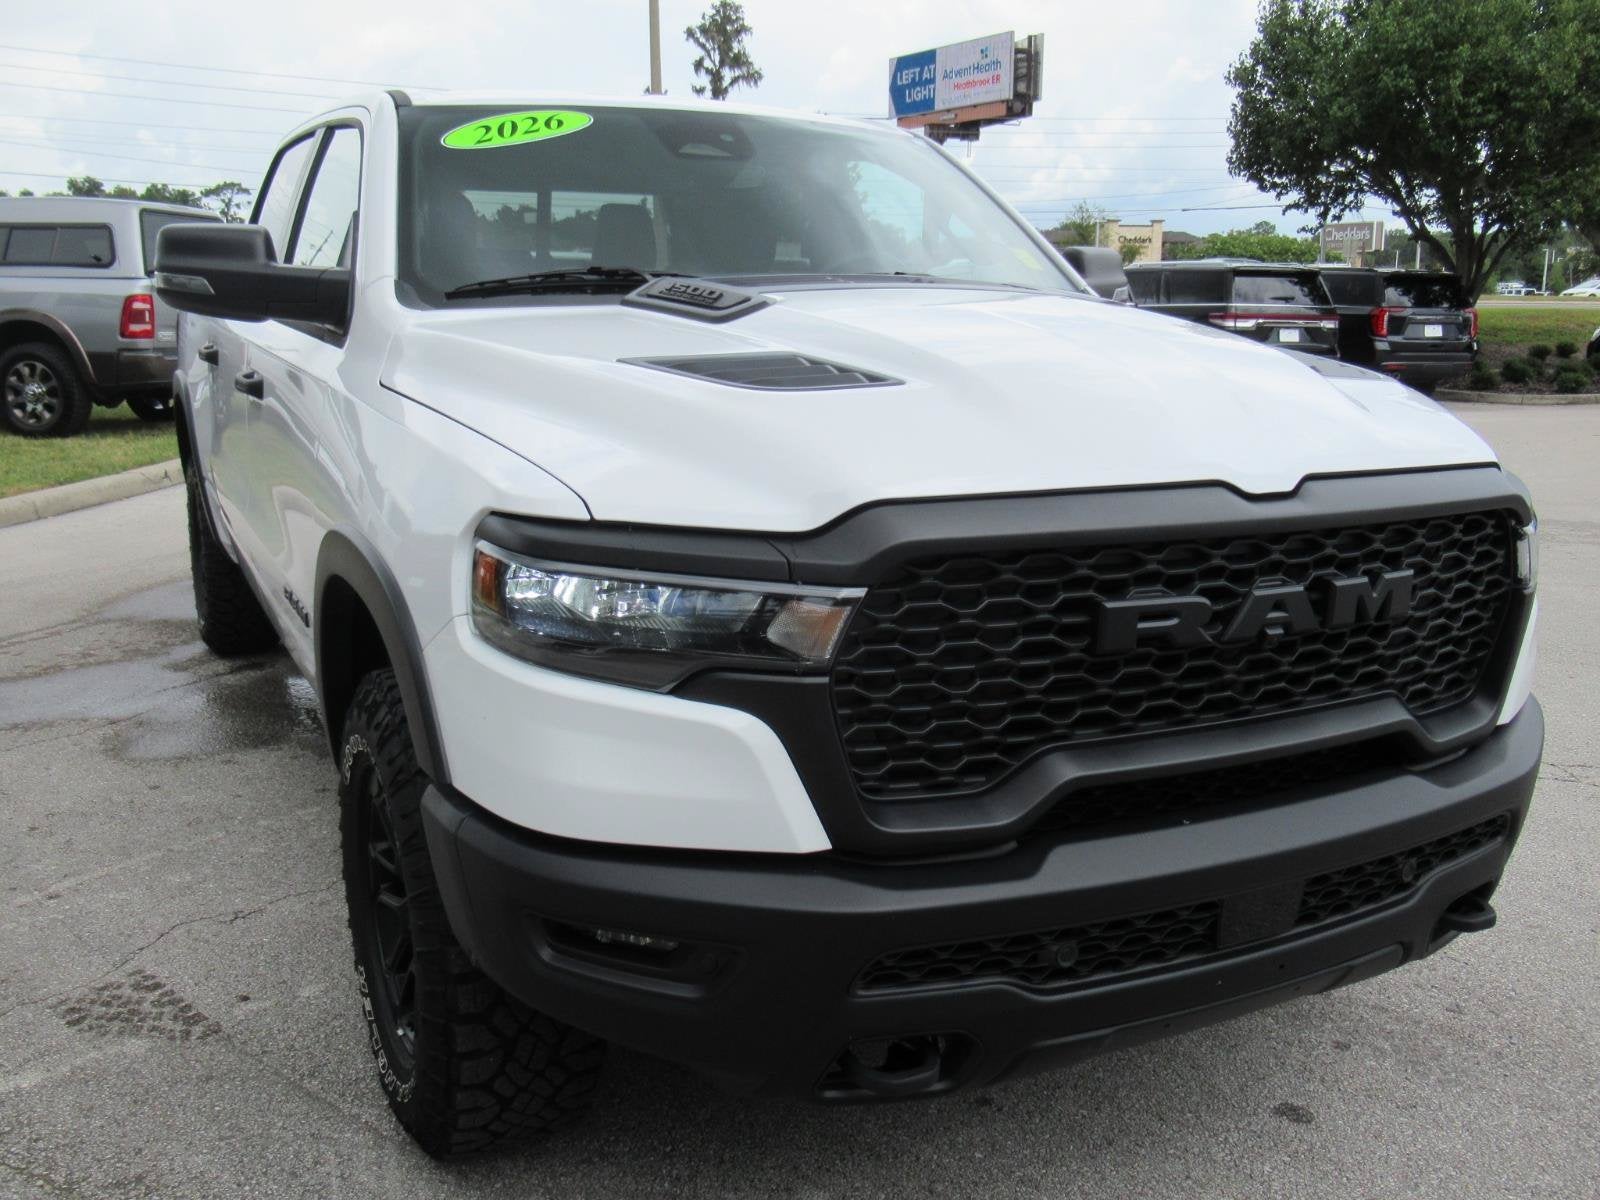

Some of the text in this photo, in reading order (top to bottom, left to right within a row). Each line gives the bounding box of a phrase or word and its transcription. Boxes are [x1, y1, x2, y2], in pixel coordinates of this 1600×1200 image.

[897, 63, 936, 86] LEFT AT
[943, 58, 1001, 80] AdventHealth
[991, 73, 1001, 85] ER
[905, 85, 936, 103] LIGHT
[473, 113, 564, 146] 2026
[1325, 226, 1370, 241] Cheddar's
[1097, 568, 1414, 651] RAM
